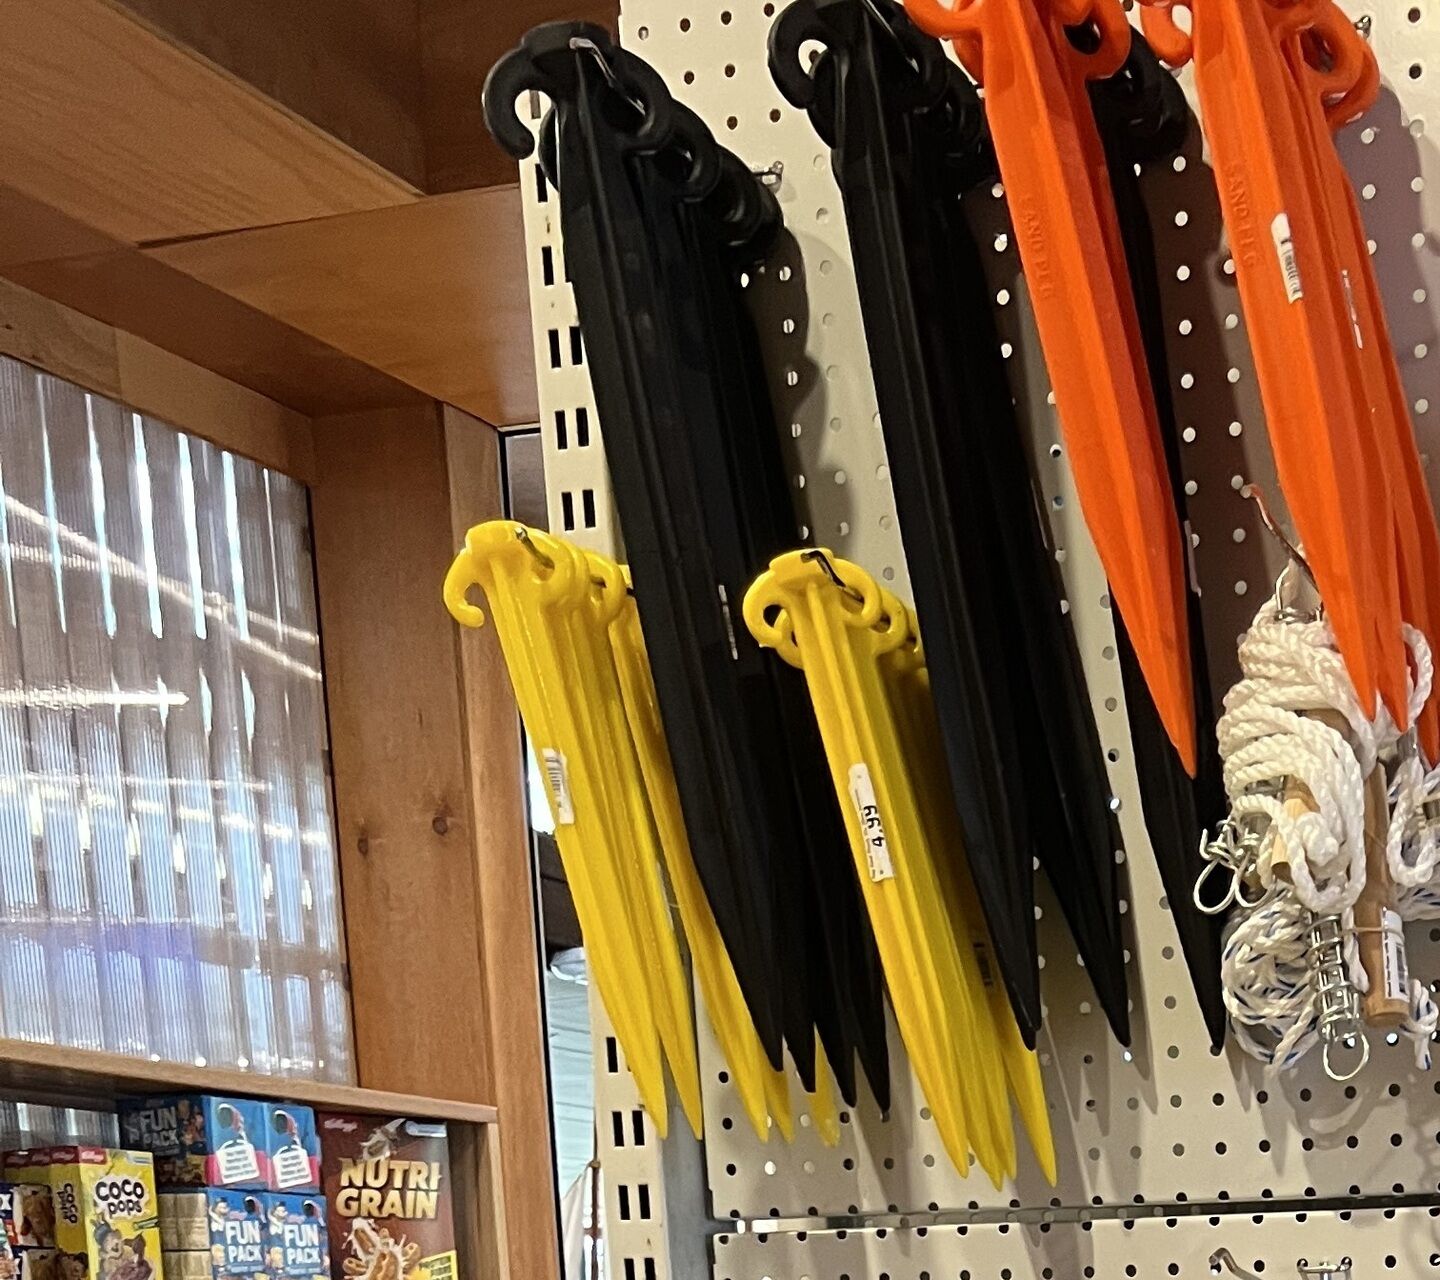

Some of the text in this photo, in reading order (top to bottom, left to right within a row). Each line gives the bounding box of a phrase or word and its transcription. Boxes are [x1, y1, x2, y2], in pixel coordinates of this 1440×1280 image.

[863, 805, 885, 847] 4.99
[95, 1179, 145, 1200] COCO
[336, 1188, 438, 1219] GRAIN
[225, 1221, 262, 1244] FUN
[284, 1224, 319, 1247] FUN
[228, 1245, 264, 1263] PACK
[287, 1247, 321, 1263] PACK
